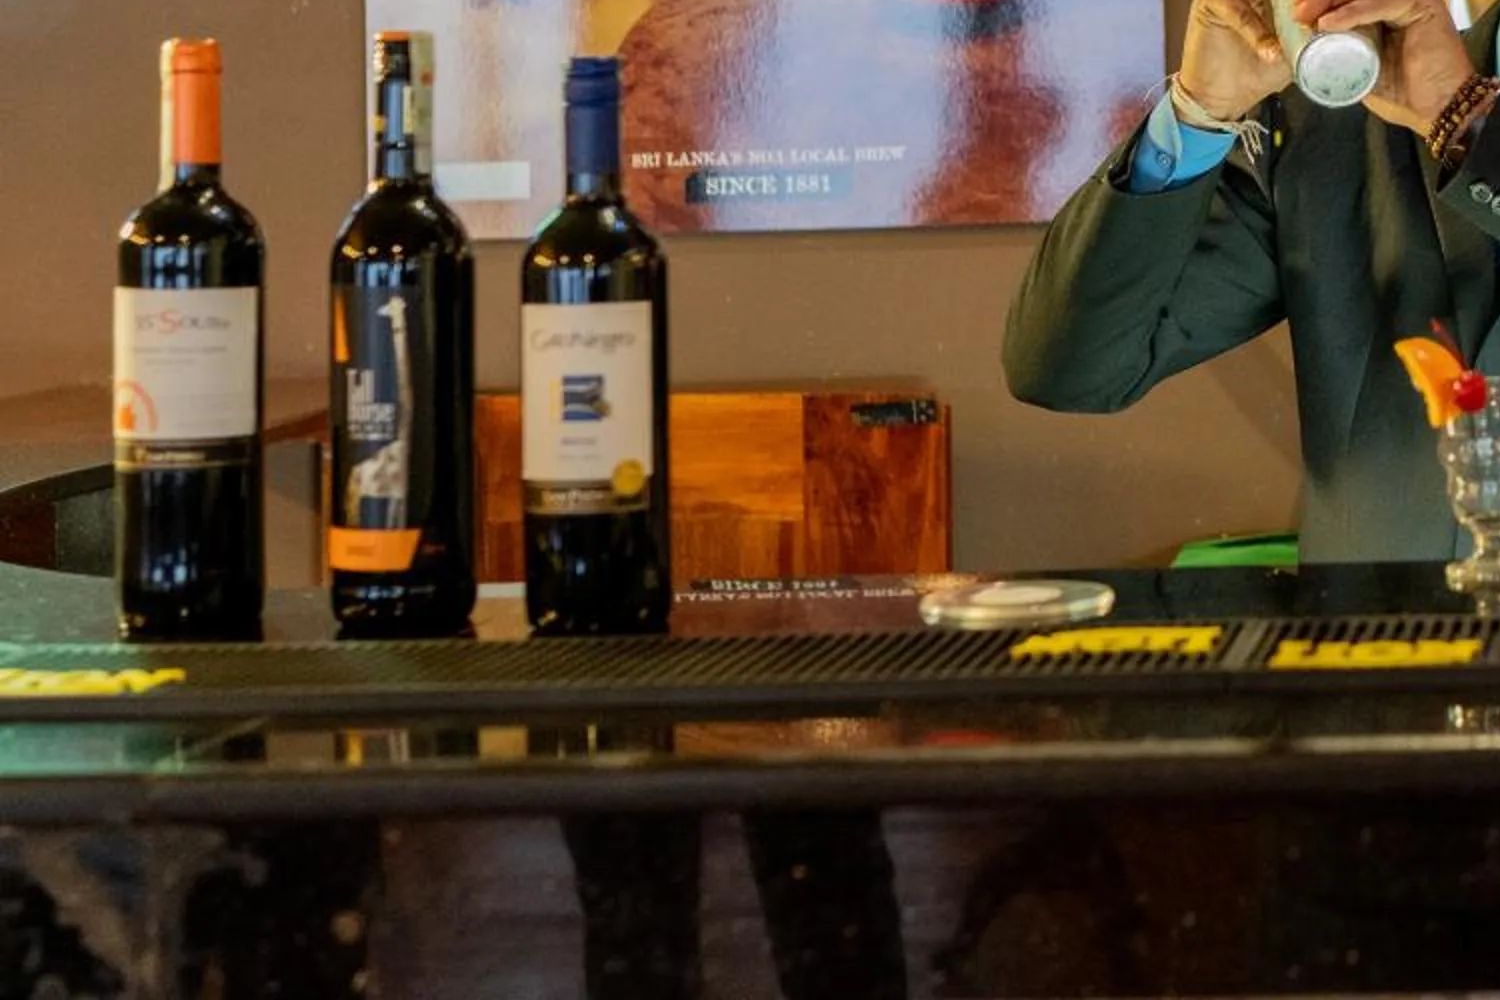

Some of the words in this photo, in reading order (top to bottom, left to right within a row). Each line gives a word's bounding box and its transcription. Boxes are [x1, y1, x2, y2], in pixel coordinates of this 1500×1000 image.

[631, 152, 661, 169] SRI
[790, 147, 850, 164] LOCAL
[705, 174, 777, 197] SINCE
[785, 173, 832, 194] 1881
